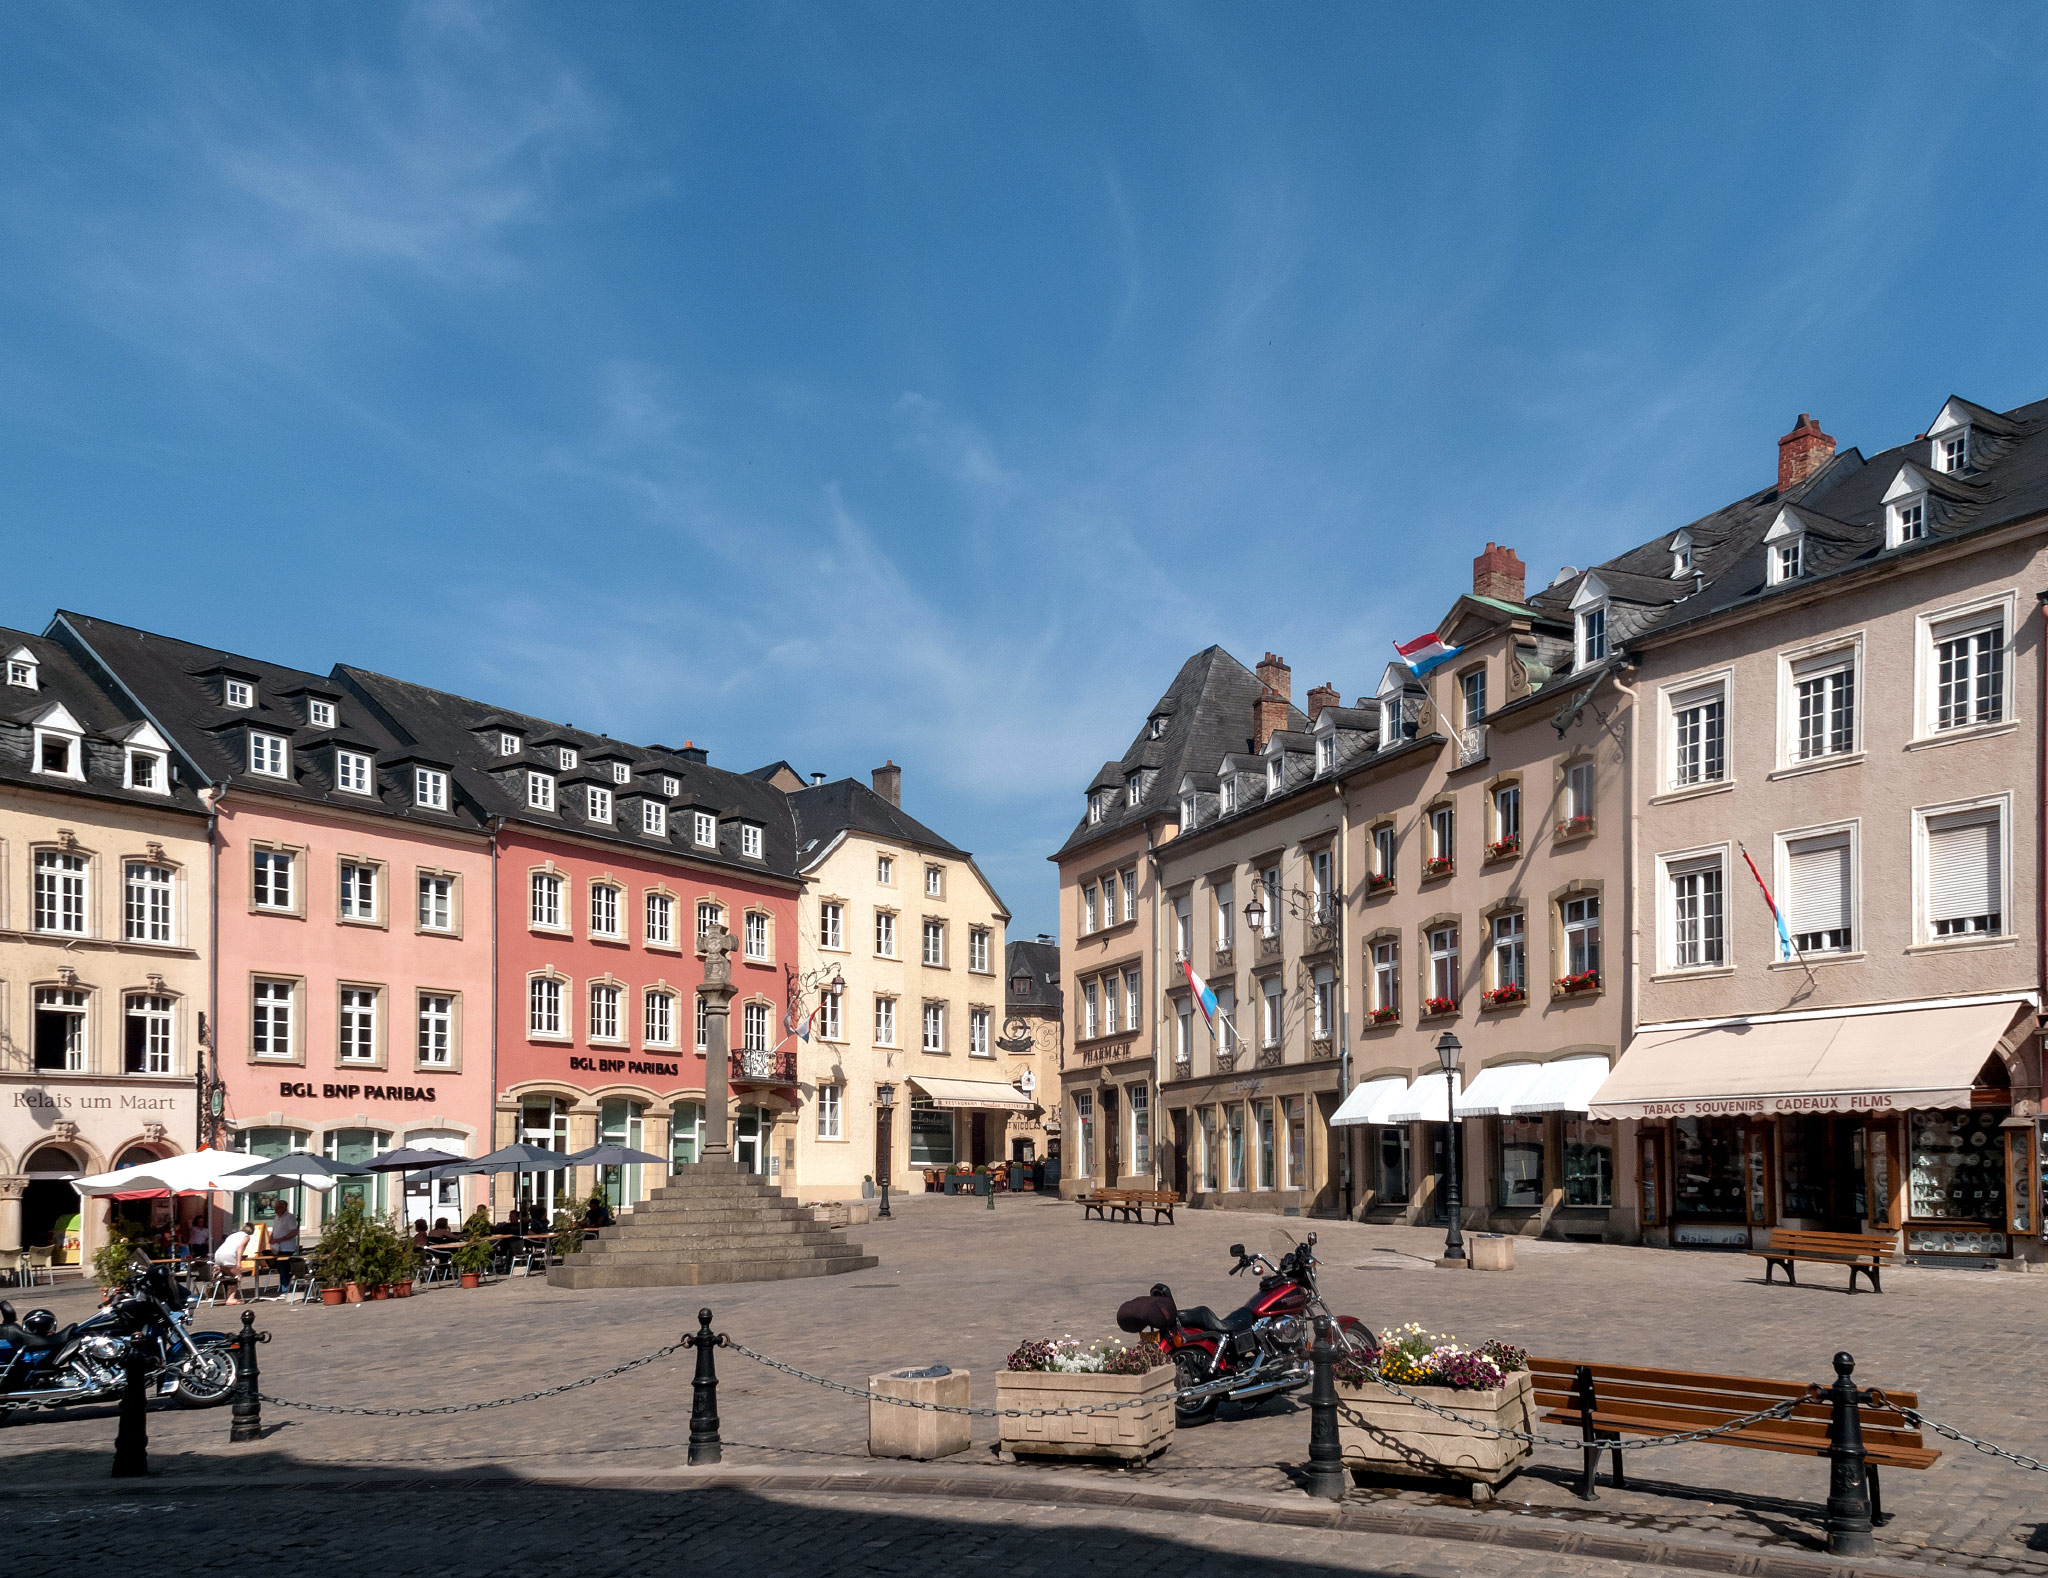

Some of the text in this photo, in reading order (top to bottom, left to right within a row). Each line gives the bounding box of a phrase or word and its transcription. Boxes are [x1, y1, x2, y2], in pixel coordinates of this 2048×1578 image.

[1083, 1043, 1131, 1066] PHARMACIE
[570, 1056, 679, 1076] BGL BNP PARIBAS
[13, 1092, 176, 1110] Relais um Maart
[280, 1082, 436, 1102] BGL BNP PARIBAS
[1642, 1095, 1892, 1115] TABACS SOUVENIRS CADEAUX FILMS
